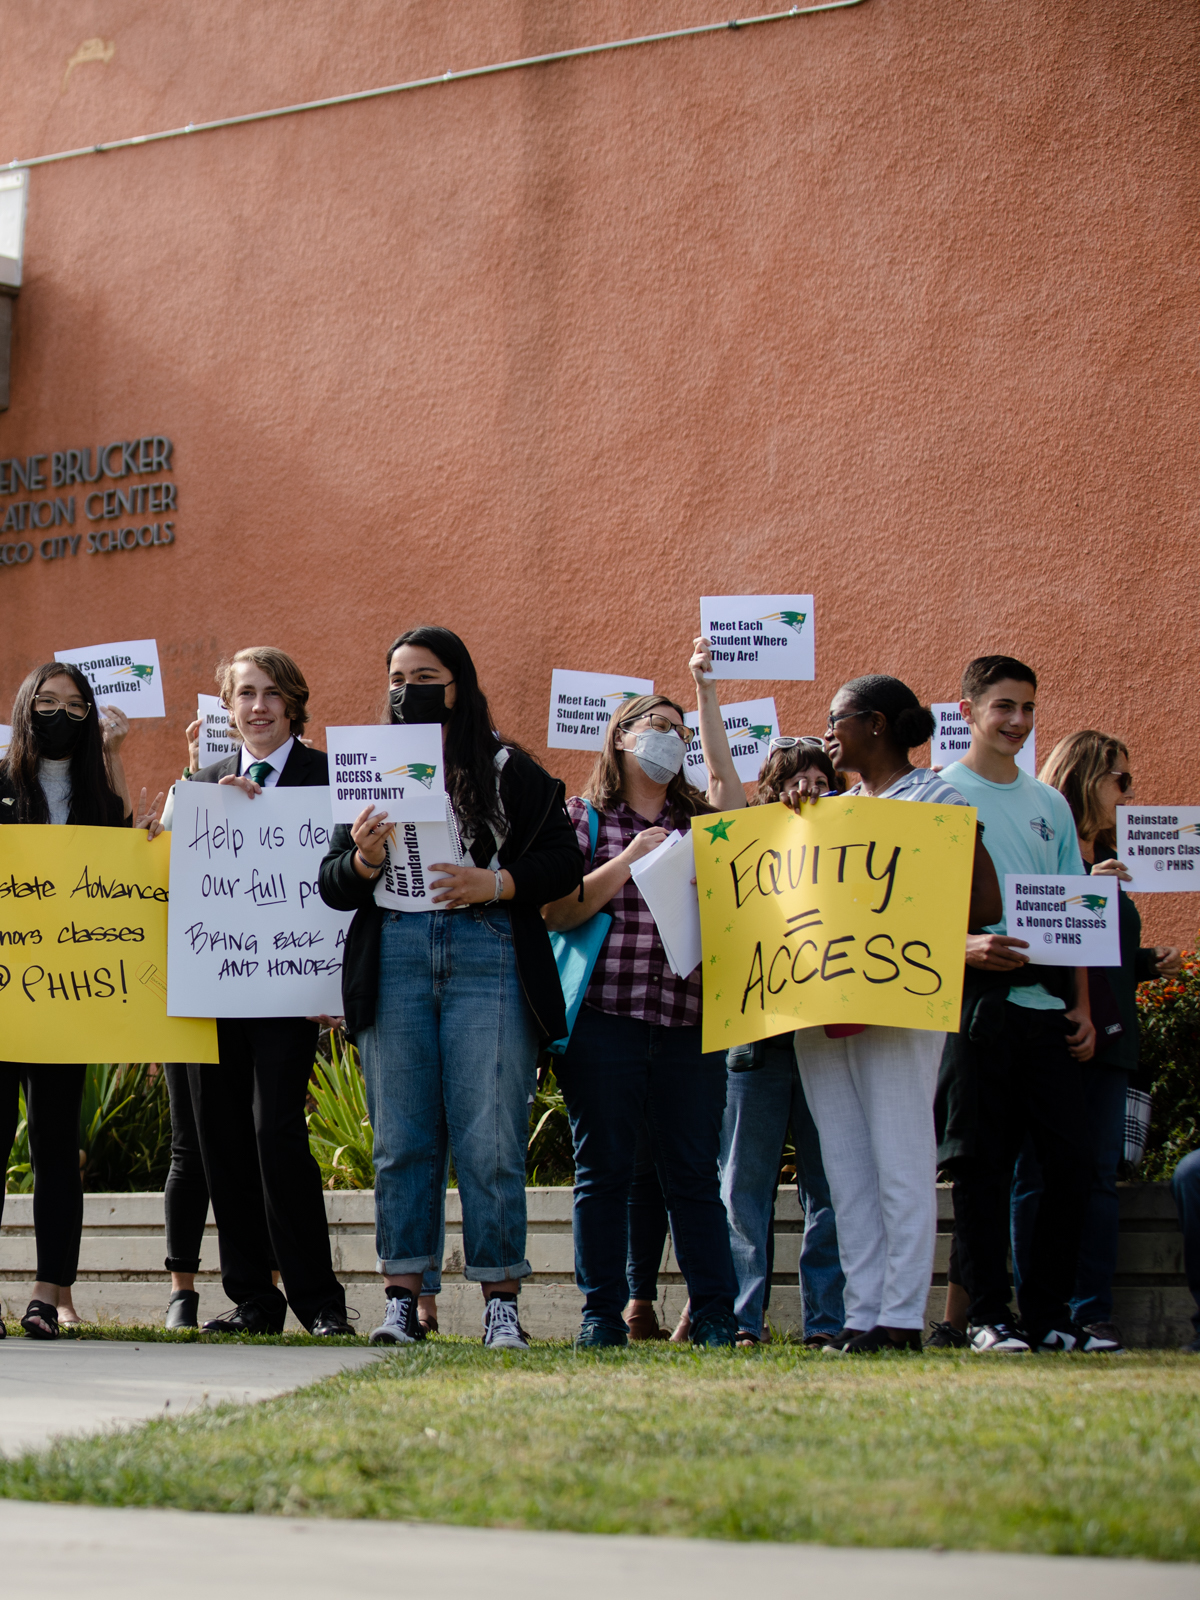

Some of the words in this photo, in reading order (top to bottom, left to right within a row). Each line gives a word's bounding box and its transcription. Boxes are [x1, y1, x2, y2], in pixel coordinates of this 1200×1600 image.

[52, 435, 174, 487] BRUCKER
[85, 482, 177, 521] CENTER
[39, 534, 81, 560] CITY
[86, 521, 175, 554] SCHOOLS
[710, 621, 737, 631] Meet
[738, 620, 763, 631] Each
[710, 635, 751, 646] Student
[753, 635, 788, 647] Where
[710, 649, 735, 662] They
[737, 650, 758, 662] Are!
[558, 694, 582, 705] Meet
[583, 696, 606, 707] Each
[557, 708, 595, 721] Student
[556, 722, 579, 734] They
[580, 725, 600, 735] Are!
[940, 726, 971, 735] Advan
[206, 742, 229, 753] They
[940, 741, 947, 750] &
[335, 753, 368, 766] EQUITY
[336, 771, 372, 783] ACCESS
[375, 772, 382, 782] &
[337, 787, 405, 800] OPPORTUNITY
[1128, 814, 1178, 825] Reinstate
[188, 806, 244, 859] Help
[259, 826, 285, 849] us
[1127, 829, 1179, 840] Advanced
[1128, 846, 1135, 856] &
[1138, 845, 1175, 856] Honors
[1177, 844, 1200, 855] Clas
[1154, 859, 1165, 871] @
[1167, 859, 1194, 871] PHHS
[394, 865, 409, 897] Don't
[730, 838, 901, 914] EQUITY
[202, 874, 240, 898] our
[244, 868, 288, 904] full
[1015, 883, 1065, 896] Reinstate
[1015, 900, 1067, 912] Advanced
[783, 908, 823, 938] =
[1016, 917, 1024, 927] &
[1026, 916, 1062, 928] Honors
[1065, 917, 1106, 929] Classes
[57, 921, 145, 944] classes
[185, 921, 258, 955] BRING
[273, 930, 324, 950] BACK
[1043, 932, 1053, 944] @
[1055, 933, 1081, 945] PHHS
[218, 958, 259, 980] AND
[267, 957, 342, 977] HONORS
[741, 934, 942, 1014] ACCESS
[22, 959, 128, 1003] PHHS!
